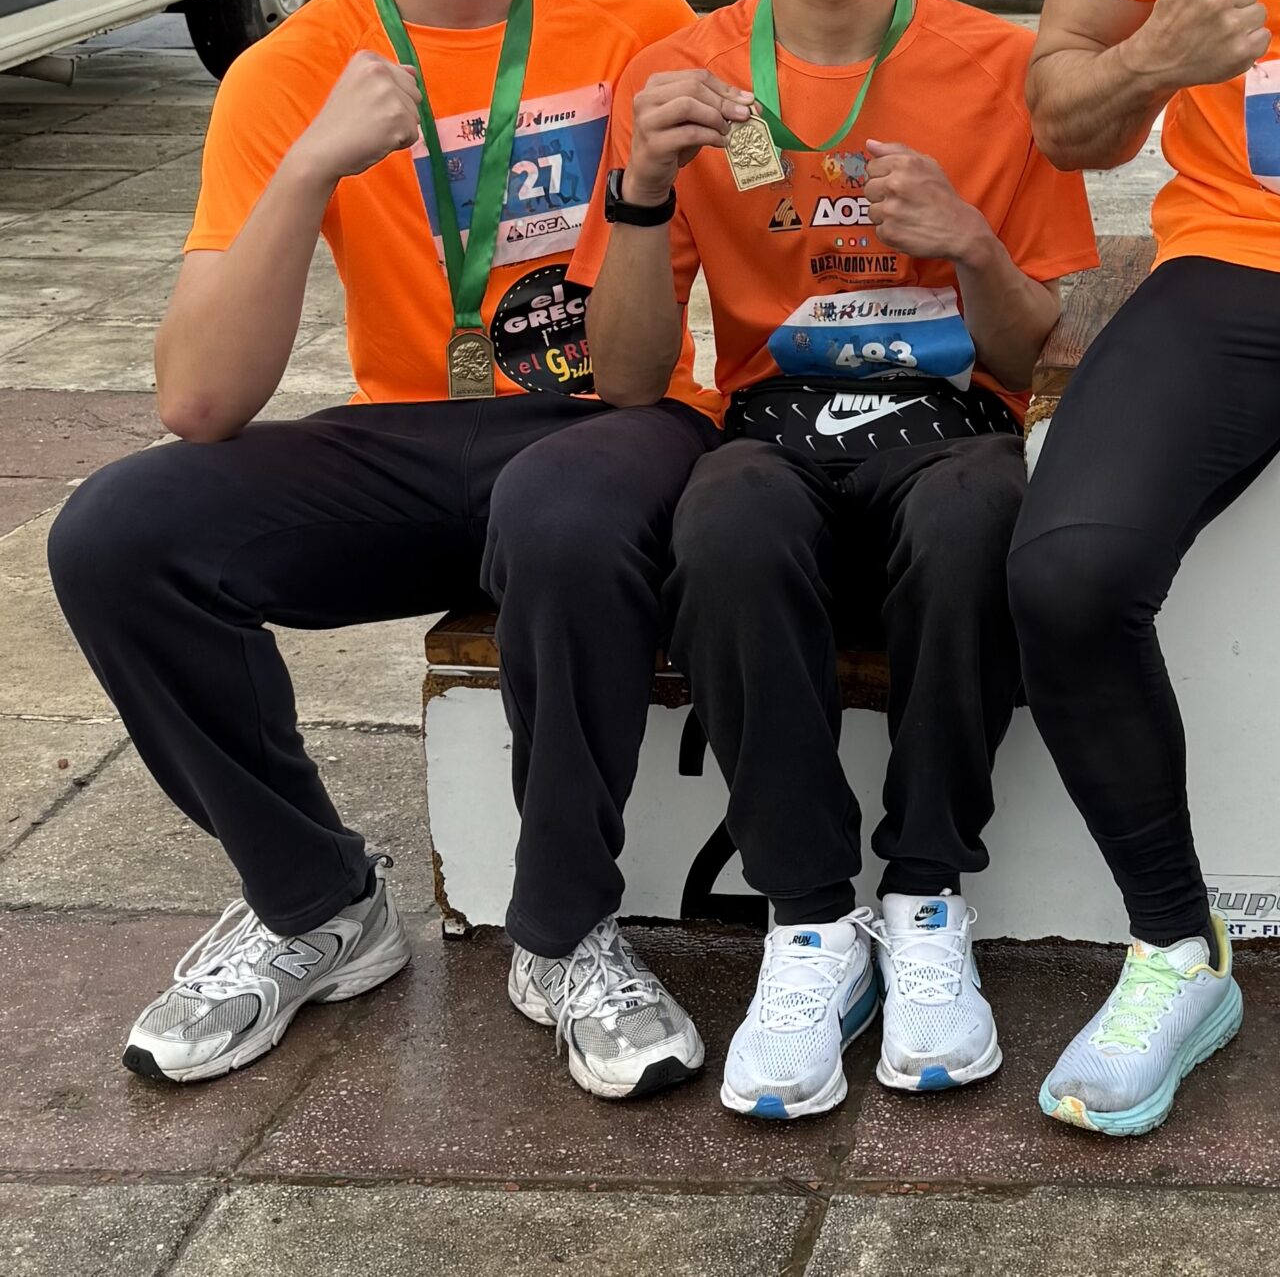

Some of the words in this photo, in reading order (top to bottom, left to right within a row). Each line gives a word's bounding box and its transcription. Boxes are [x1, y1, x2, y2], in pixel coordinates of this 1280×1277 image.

[503, 154, 563, 204] 27
[810, 196, 876, 227] ΔΟΞ
[531, 284, 565, 309] el
[504, 297, 588, 333] GREC
[519, 354, 542, 374] el
